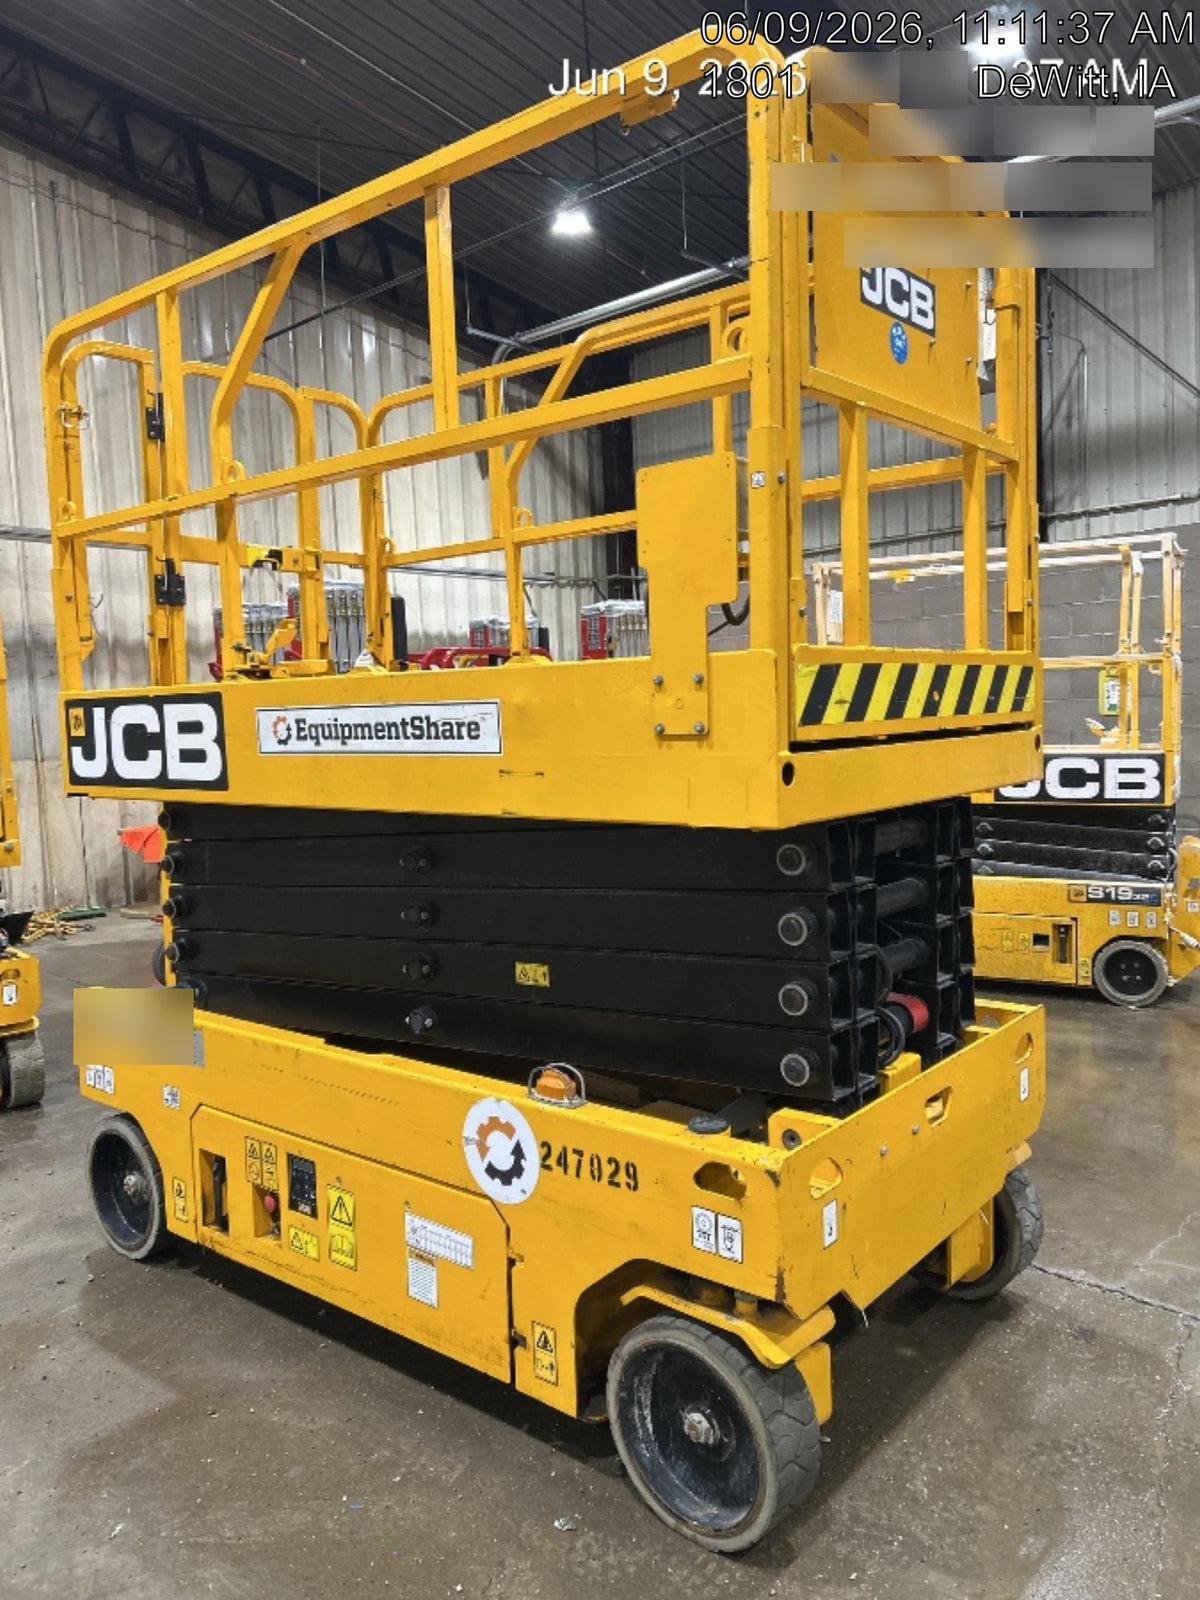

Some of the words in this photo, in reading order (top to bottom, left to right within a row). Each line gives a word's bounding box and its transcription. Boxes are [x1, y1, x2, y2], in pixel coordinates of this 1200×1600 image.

[862, 268, 935, 330] JCB
[70, 703, 223, 782] JCB
[295, 715, 481, 746] EquipmentShare
[539, 1140, 640, 1192] 247029
